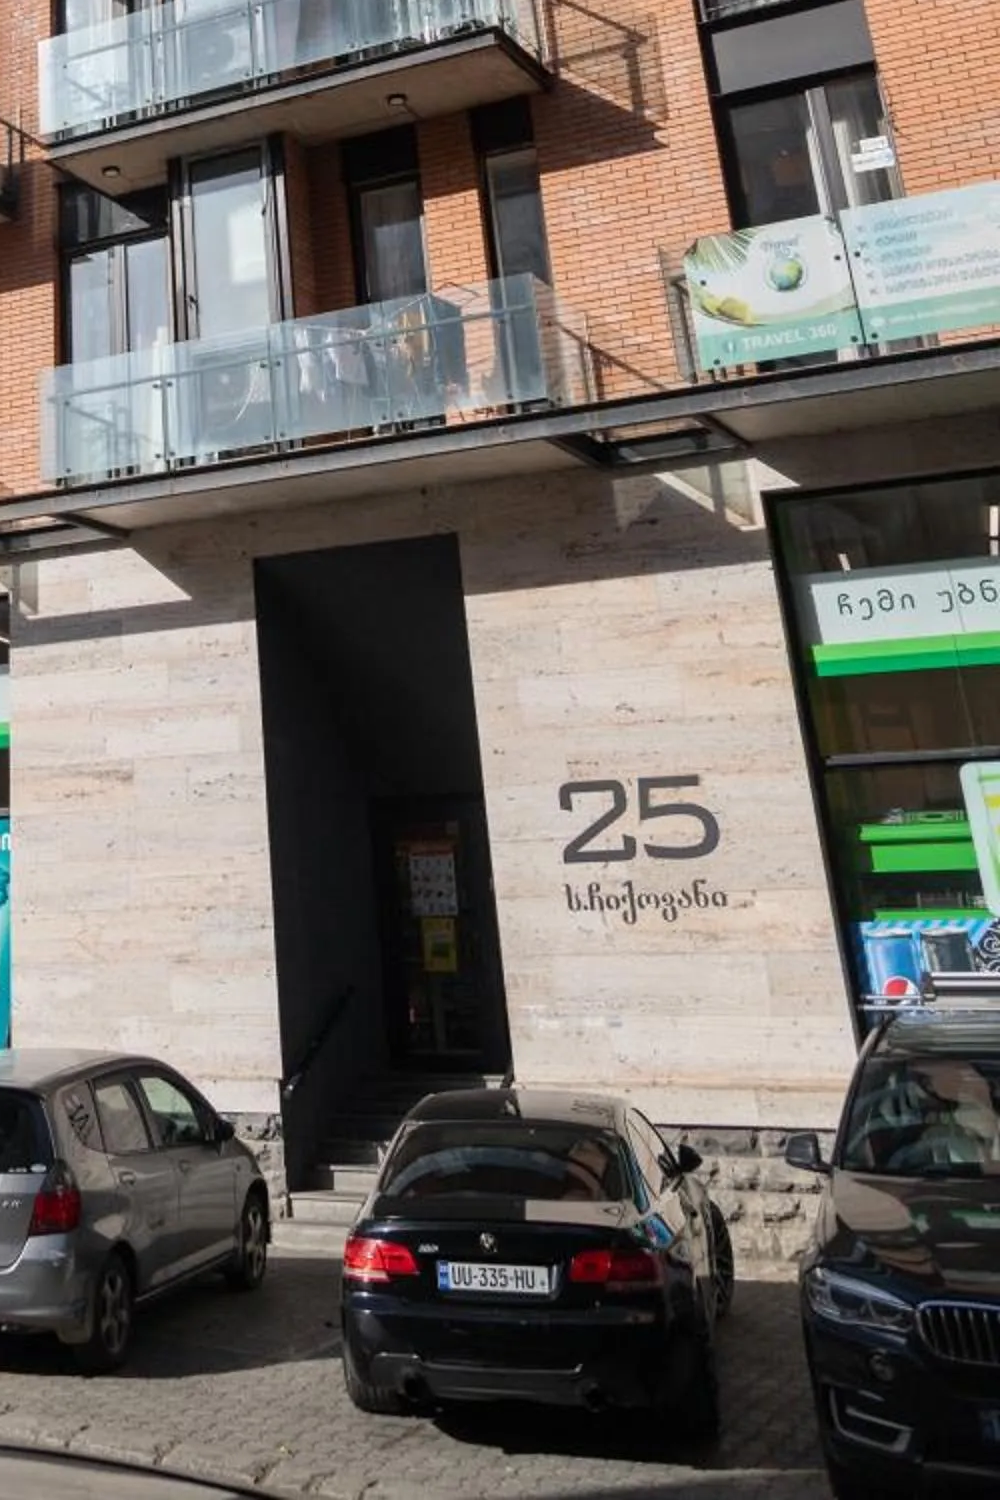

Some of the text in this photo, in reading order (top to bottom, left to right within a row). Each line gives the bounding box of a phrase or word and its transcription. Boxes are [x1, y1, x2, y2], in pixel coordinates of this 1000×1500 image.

[741, 328, 805, 351] TRAVEL
[837, 589, 916, 621] ჩემი
[558, 774, 721, 865] 25
[451, 1264, 536, 1290] UU-335-HU
